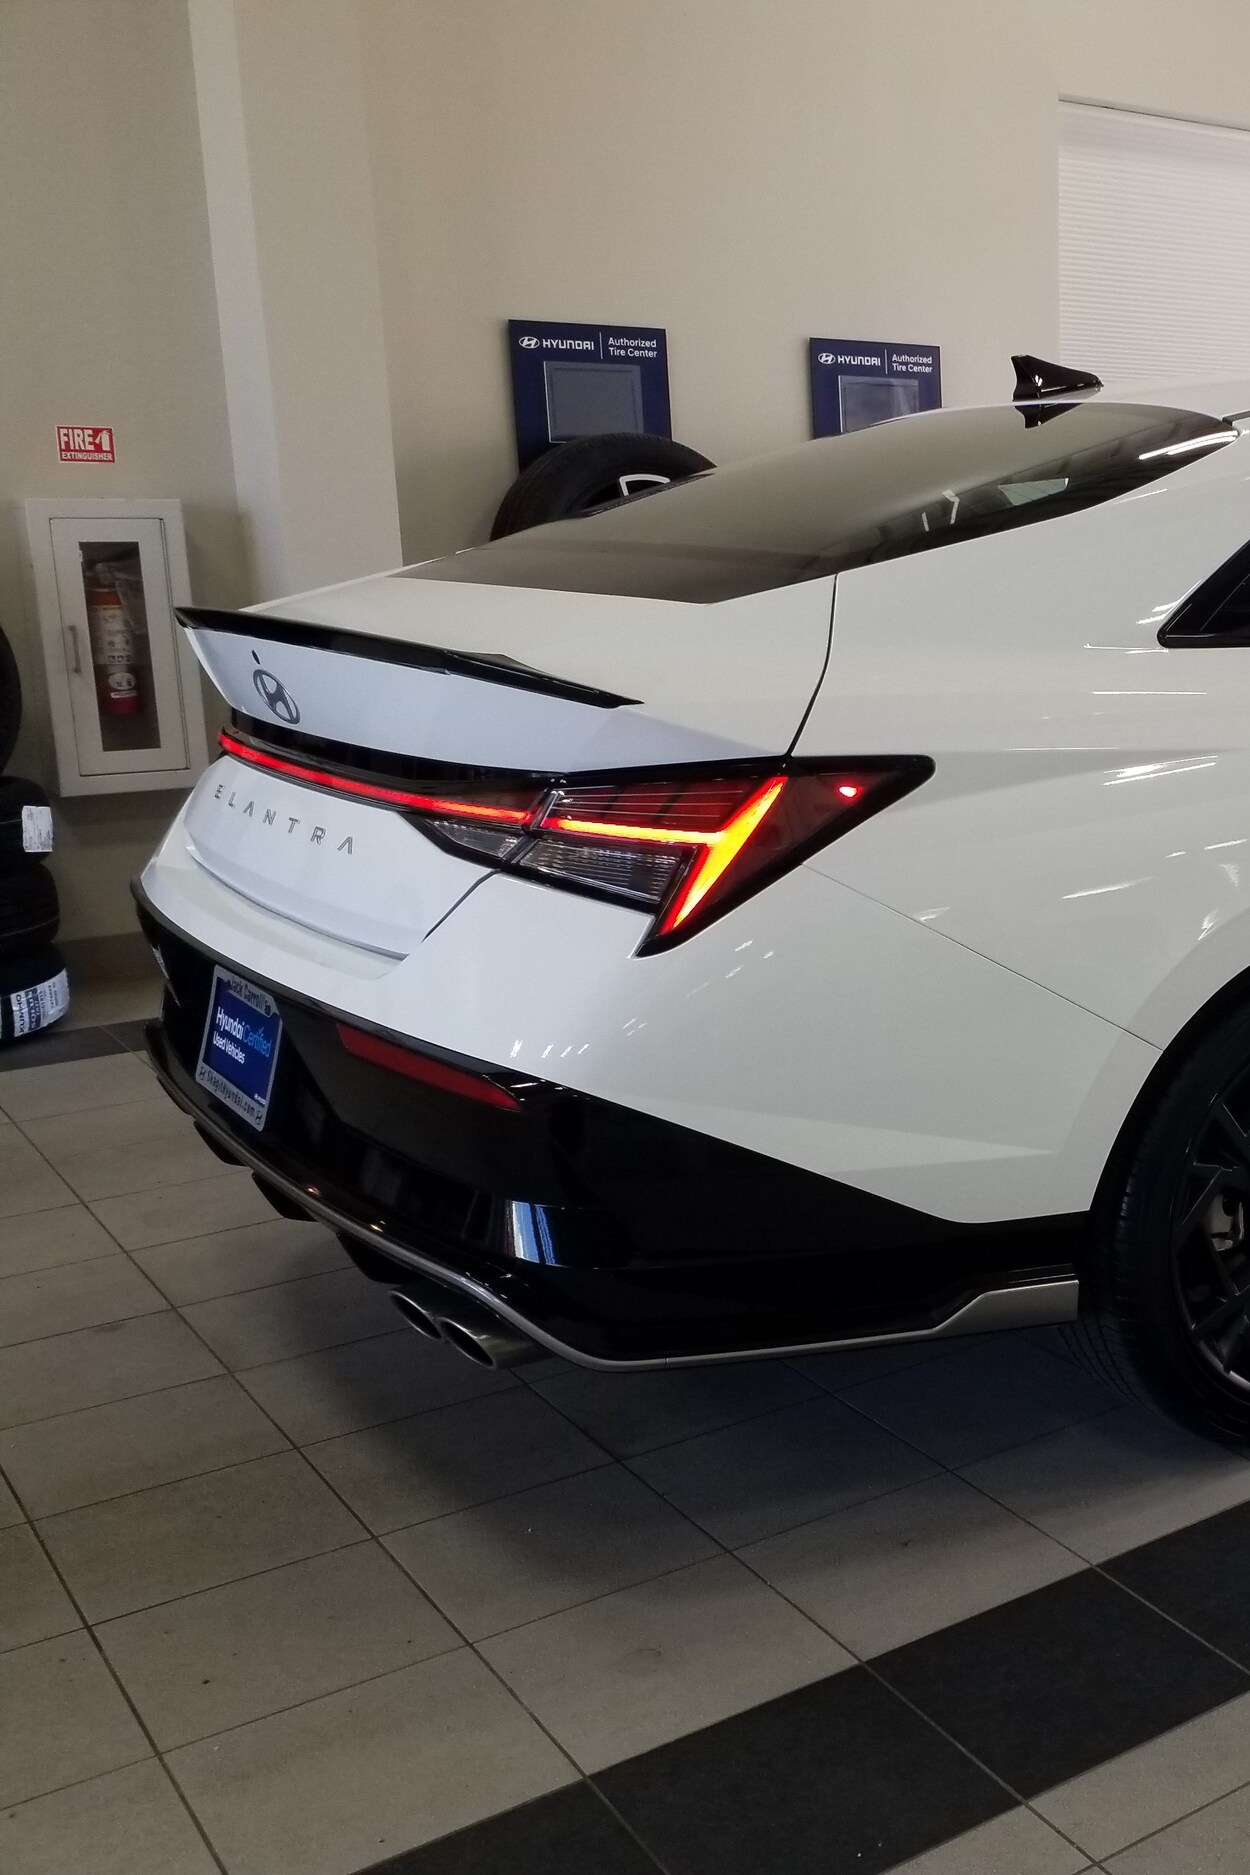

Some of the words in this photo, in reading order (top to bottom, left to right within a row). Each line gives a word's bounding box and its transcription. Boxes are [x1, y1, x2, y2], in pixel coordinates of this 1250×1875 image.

[542, 339, 594, 351] HYUNDAI
[608, 337, 657, 348] Authorized
[609, 347, 626, 356] Tire
[627, 349, 657, 358] Center
[837, 355, 881, 367] HYUNDAI
[892, 354, 933, 364] Authorized
[892, 363, 907, 372] Tire
[907, 364, 933, 373] Center
[59, 428, 95, 450] FIRE
[61, 452, 113, 461] EXTINGUISHER
[214, 784, 354, 855] ELANTRA
[216, 1006, 245, 1040] Hyundai
[243, 1025, 273, 1057] Certified
[212, 1031, 227, 1051] Used
[225, 1037, 246, 1064] Vehicles
